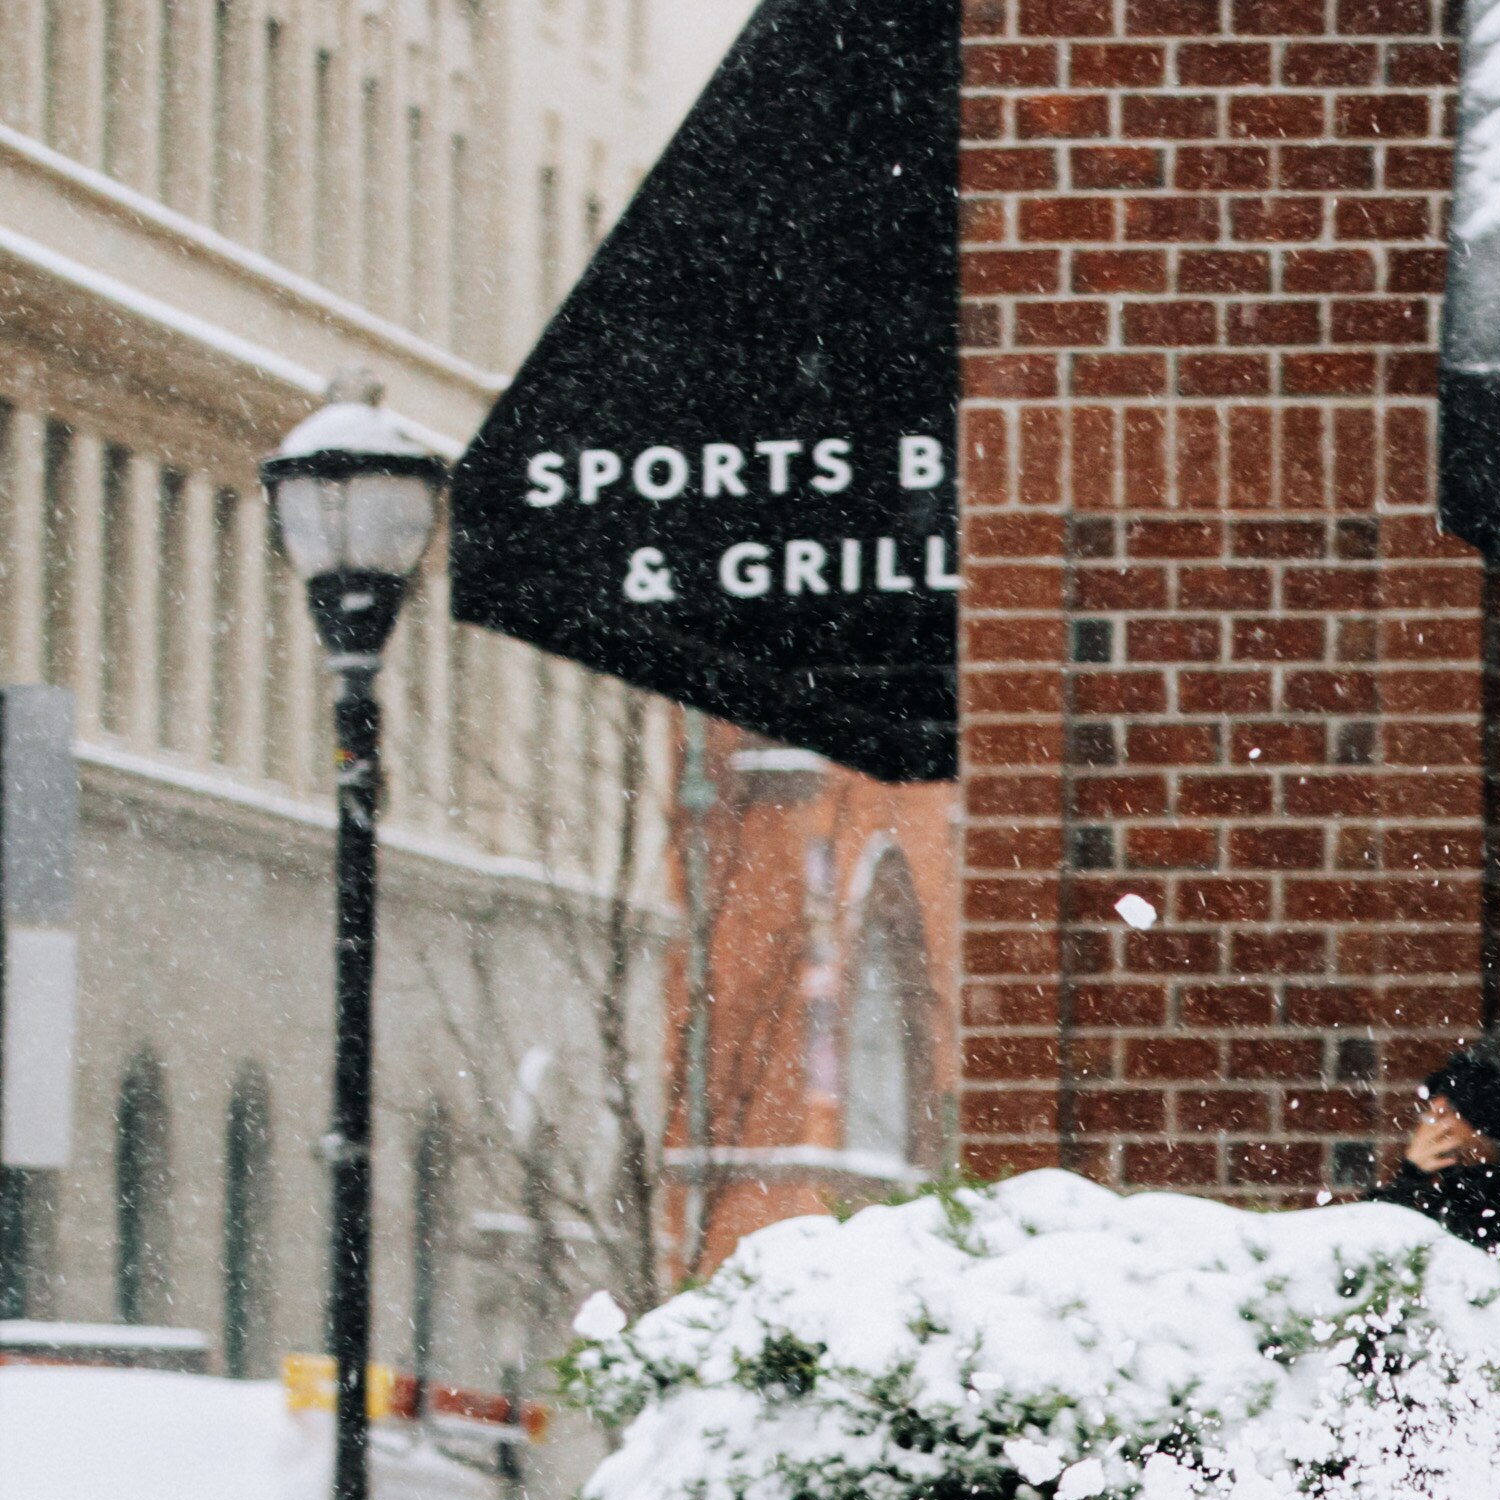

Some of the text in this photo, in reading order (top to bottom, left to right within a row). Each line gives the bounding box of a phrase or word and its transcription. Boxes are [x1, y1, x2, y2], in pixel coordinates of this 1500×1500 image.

[526, 438, 853, 508] SPORTS
[624, 535, 963, 603] & GRILL
